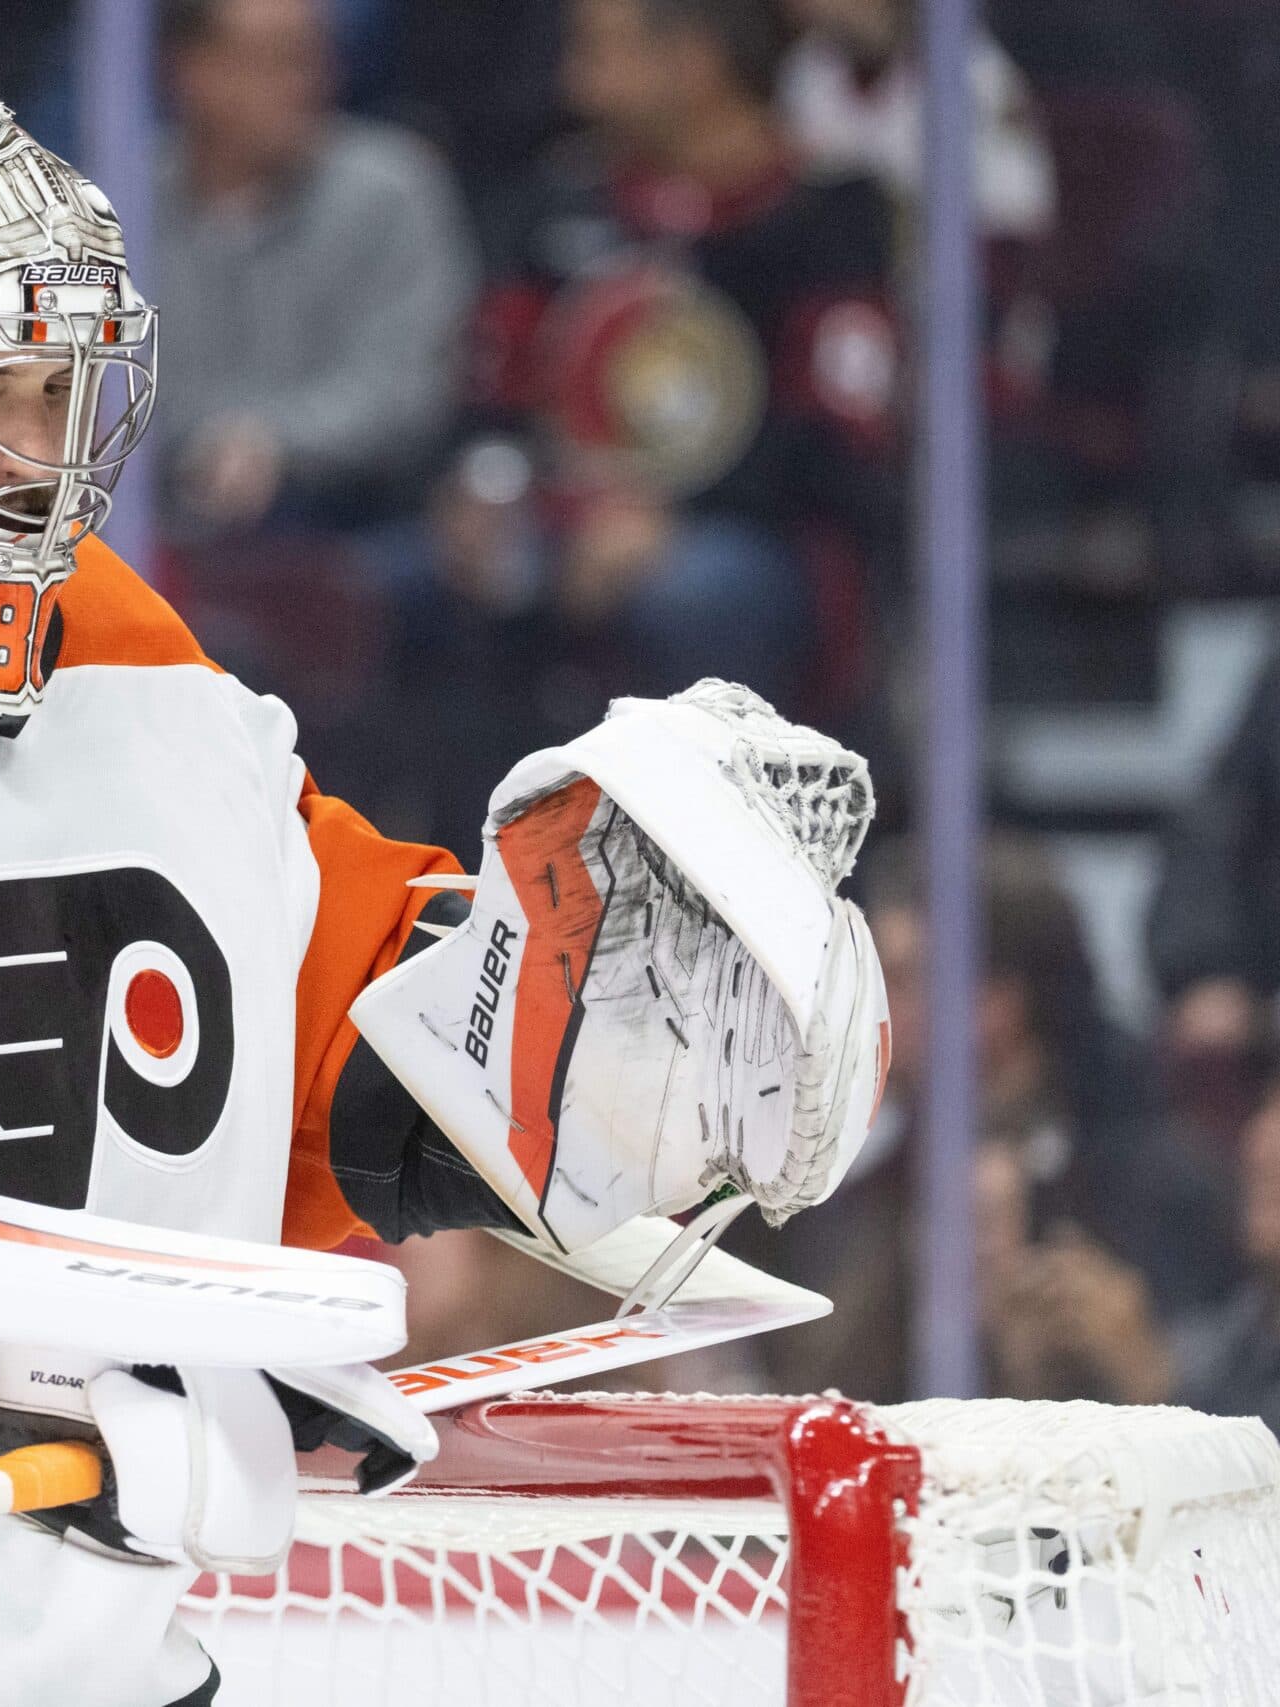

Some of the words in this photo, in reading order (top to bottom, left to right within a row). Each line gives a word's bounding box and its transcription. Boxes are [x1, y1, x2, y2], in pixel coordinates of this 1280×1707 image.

[22, 265, 117, 285] BAUER
[464, 918, 519, 1070] BAUER
[29, 1369, 86, 1390] VLADAR
[386, 1327, 668, 1397] AUER
